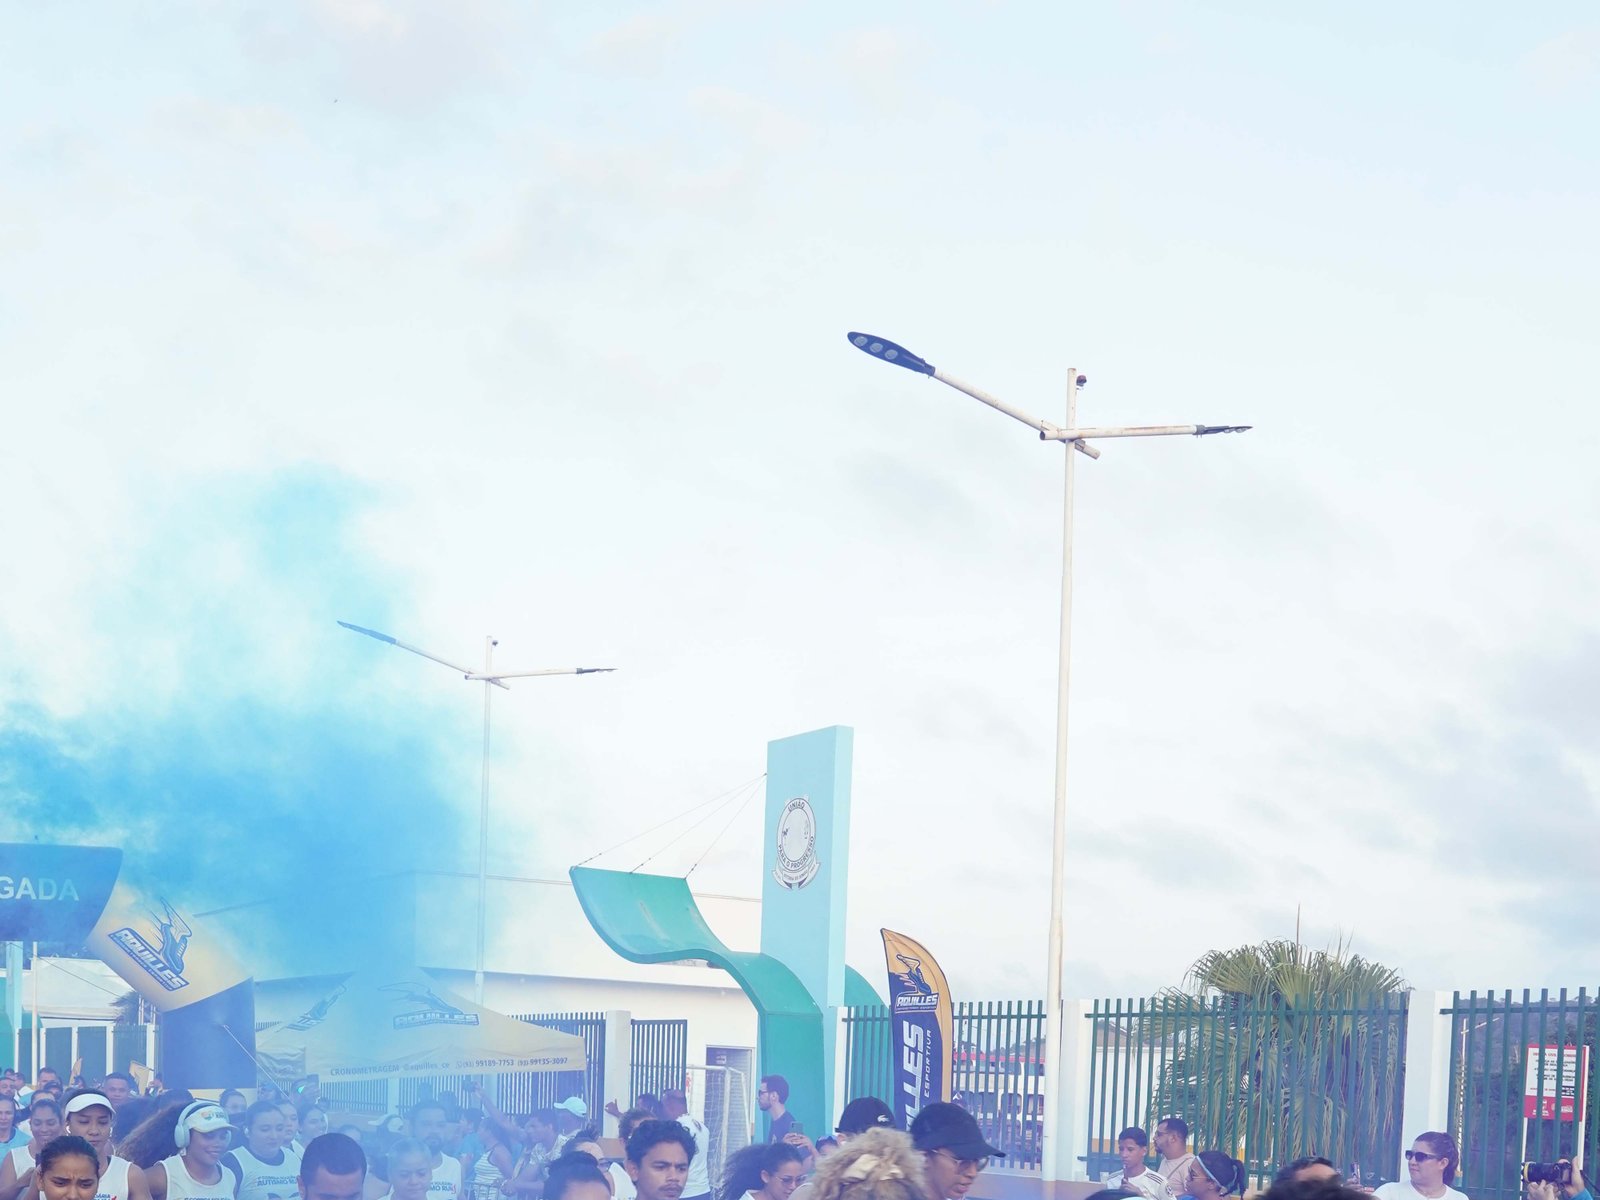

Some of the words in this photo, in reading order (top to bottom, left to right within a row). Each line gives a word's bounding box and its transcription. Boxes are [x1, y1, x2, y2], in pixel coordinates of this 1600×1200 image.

[897, 994, 938, 1007] AQUILLES
[923, 1029, 932, 1098] ESPORTIVA
[330, 1064, 400, 1077] CRONOMETRAGEM
